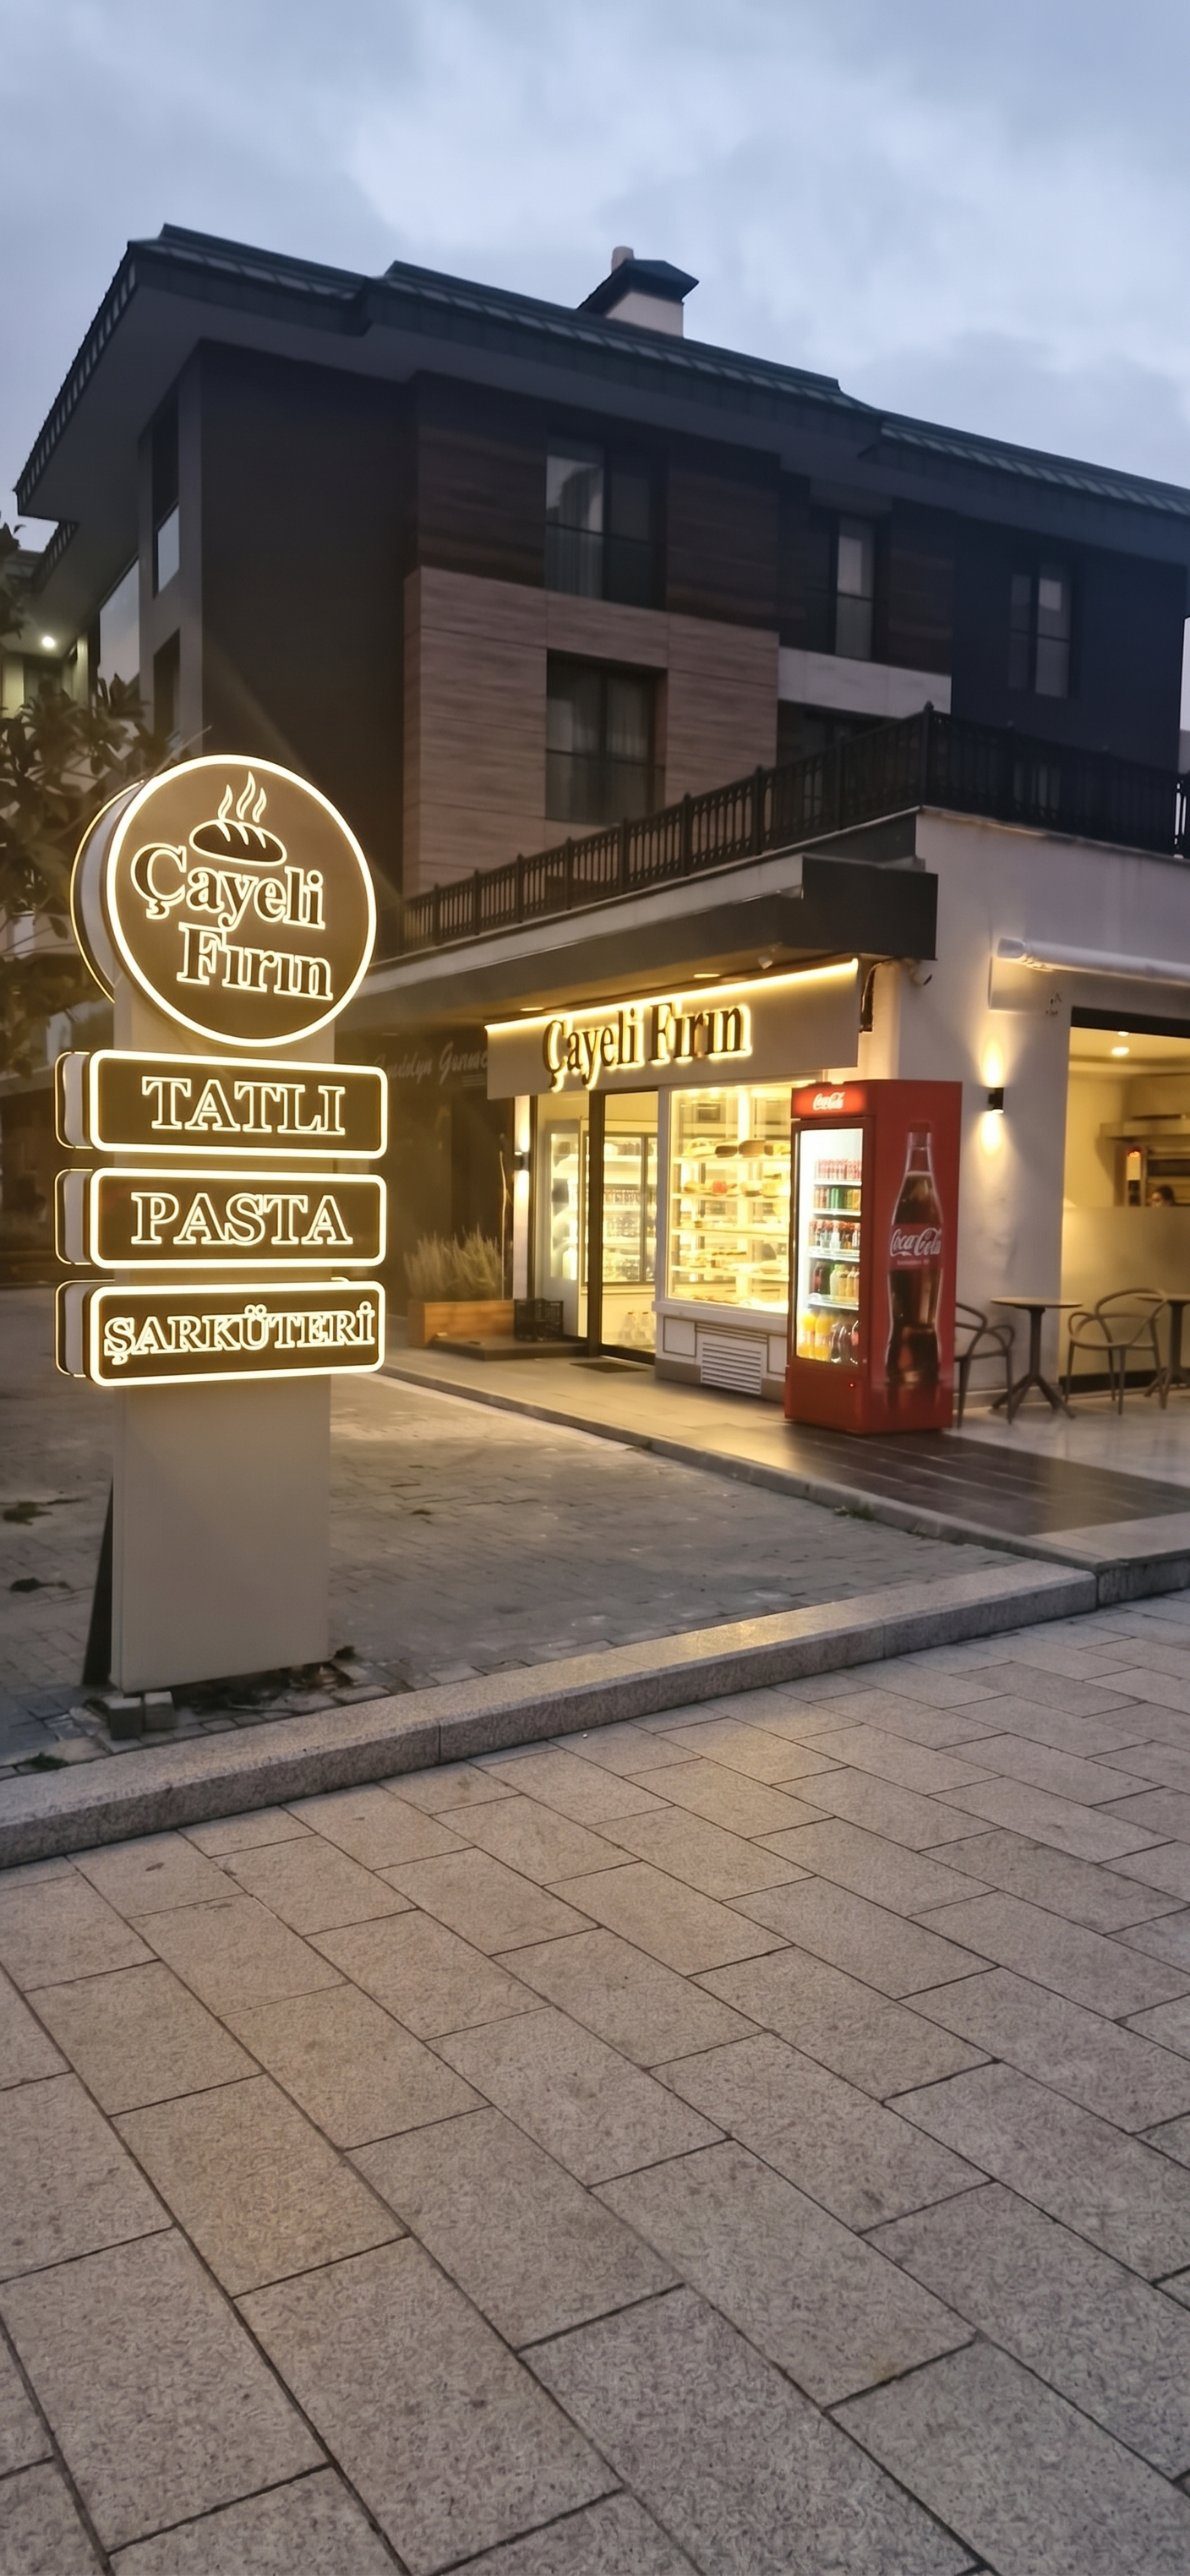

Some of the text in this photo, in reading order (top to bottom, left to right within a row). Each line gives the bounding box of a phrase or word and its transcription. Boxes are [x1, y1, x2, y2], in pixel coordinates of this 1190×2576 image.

[131, 843, 325, 932] Çayeli
[177, 921, 333, 1000] Fırın
[543, 1002, 749, 1090] Çayeli Fırın
[142, 1076, 345, 1136] TATLI
[131, 1192, 353, 1246] PASTA
[104, 1301, 375, 1365] ŞARKÜTERİ
